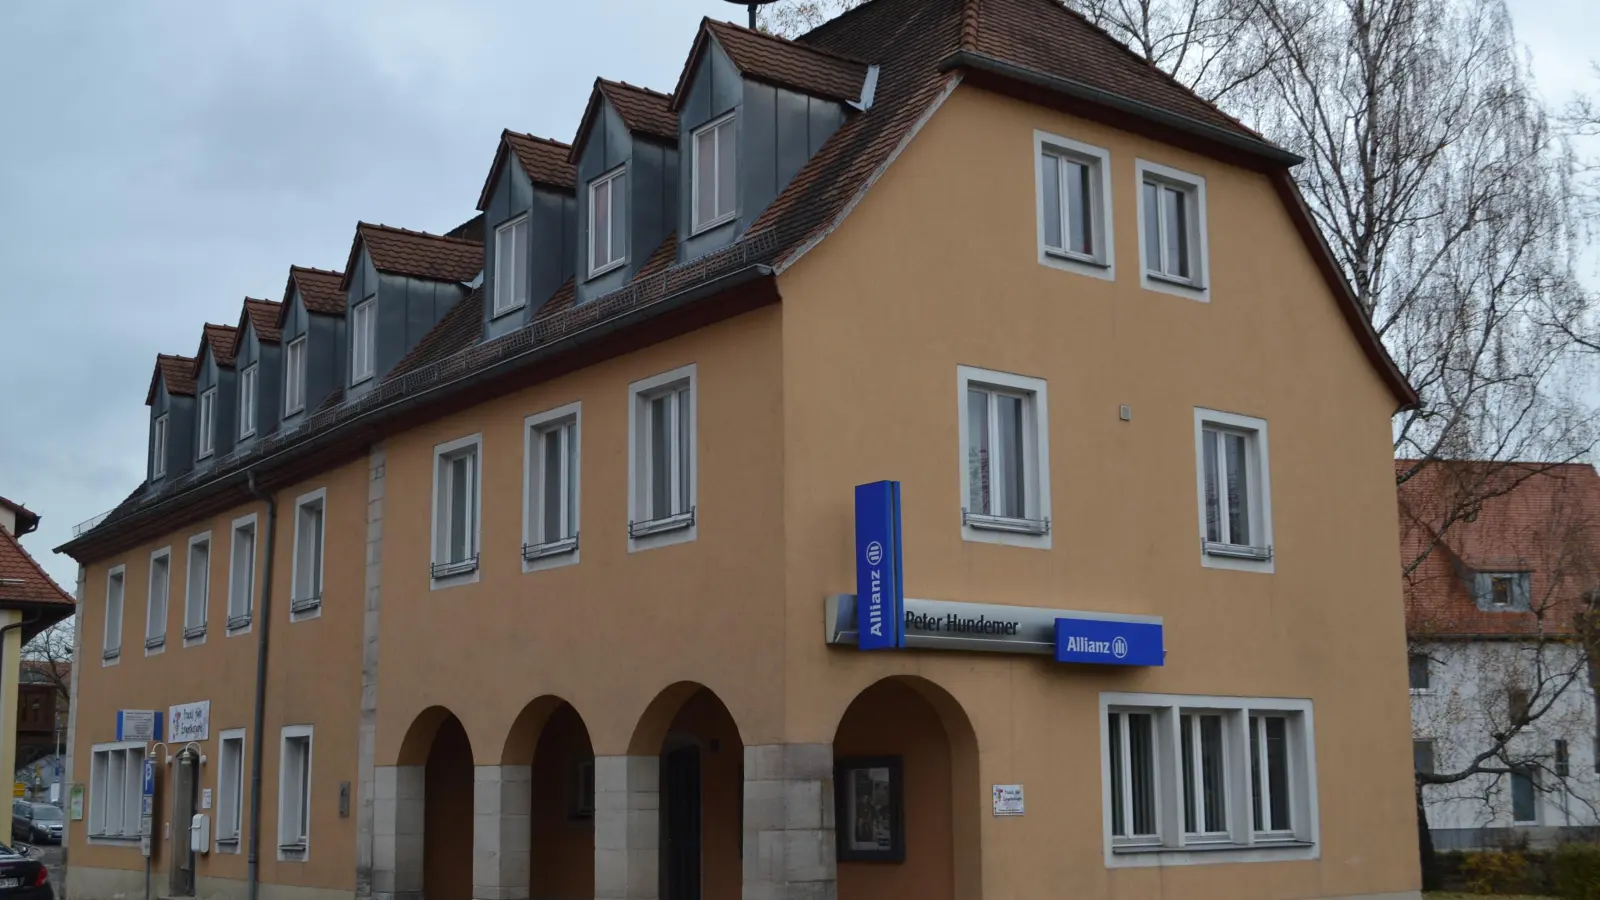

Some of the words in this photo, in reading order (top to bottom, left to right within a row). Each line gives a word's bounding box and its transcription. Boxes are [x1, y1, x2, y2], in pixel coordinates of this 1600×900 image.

[869, 569, 883, 637] Allianz
[906, 610, 943, 632] Peter
[946, 613, 1019, 636] Hundemer
[1066, 636, 1110, 654] Allianz
